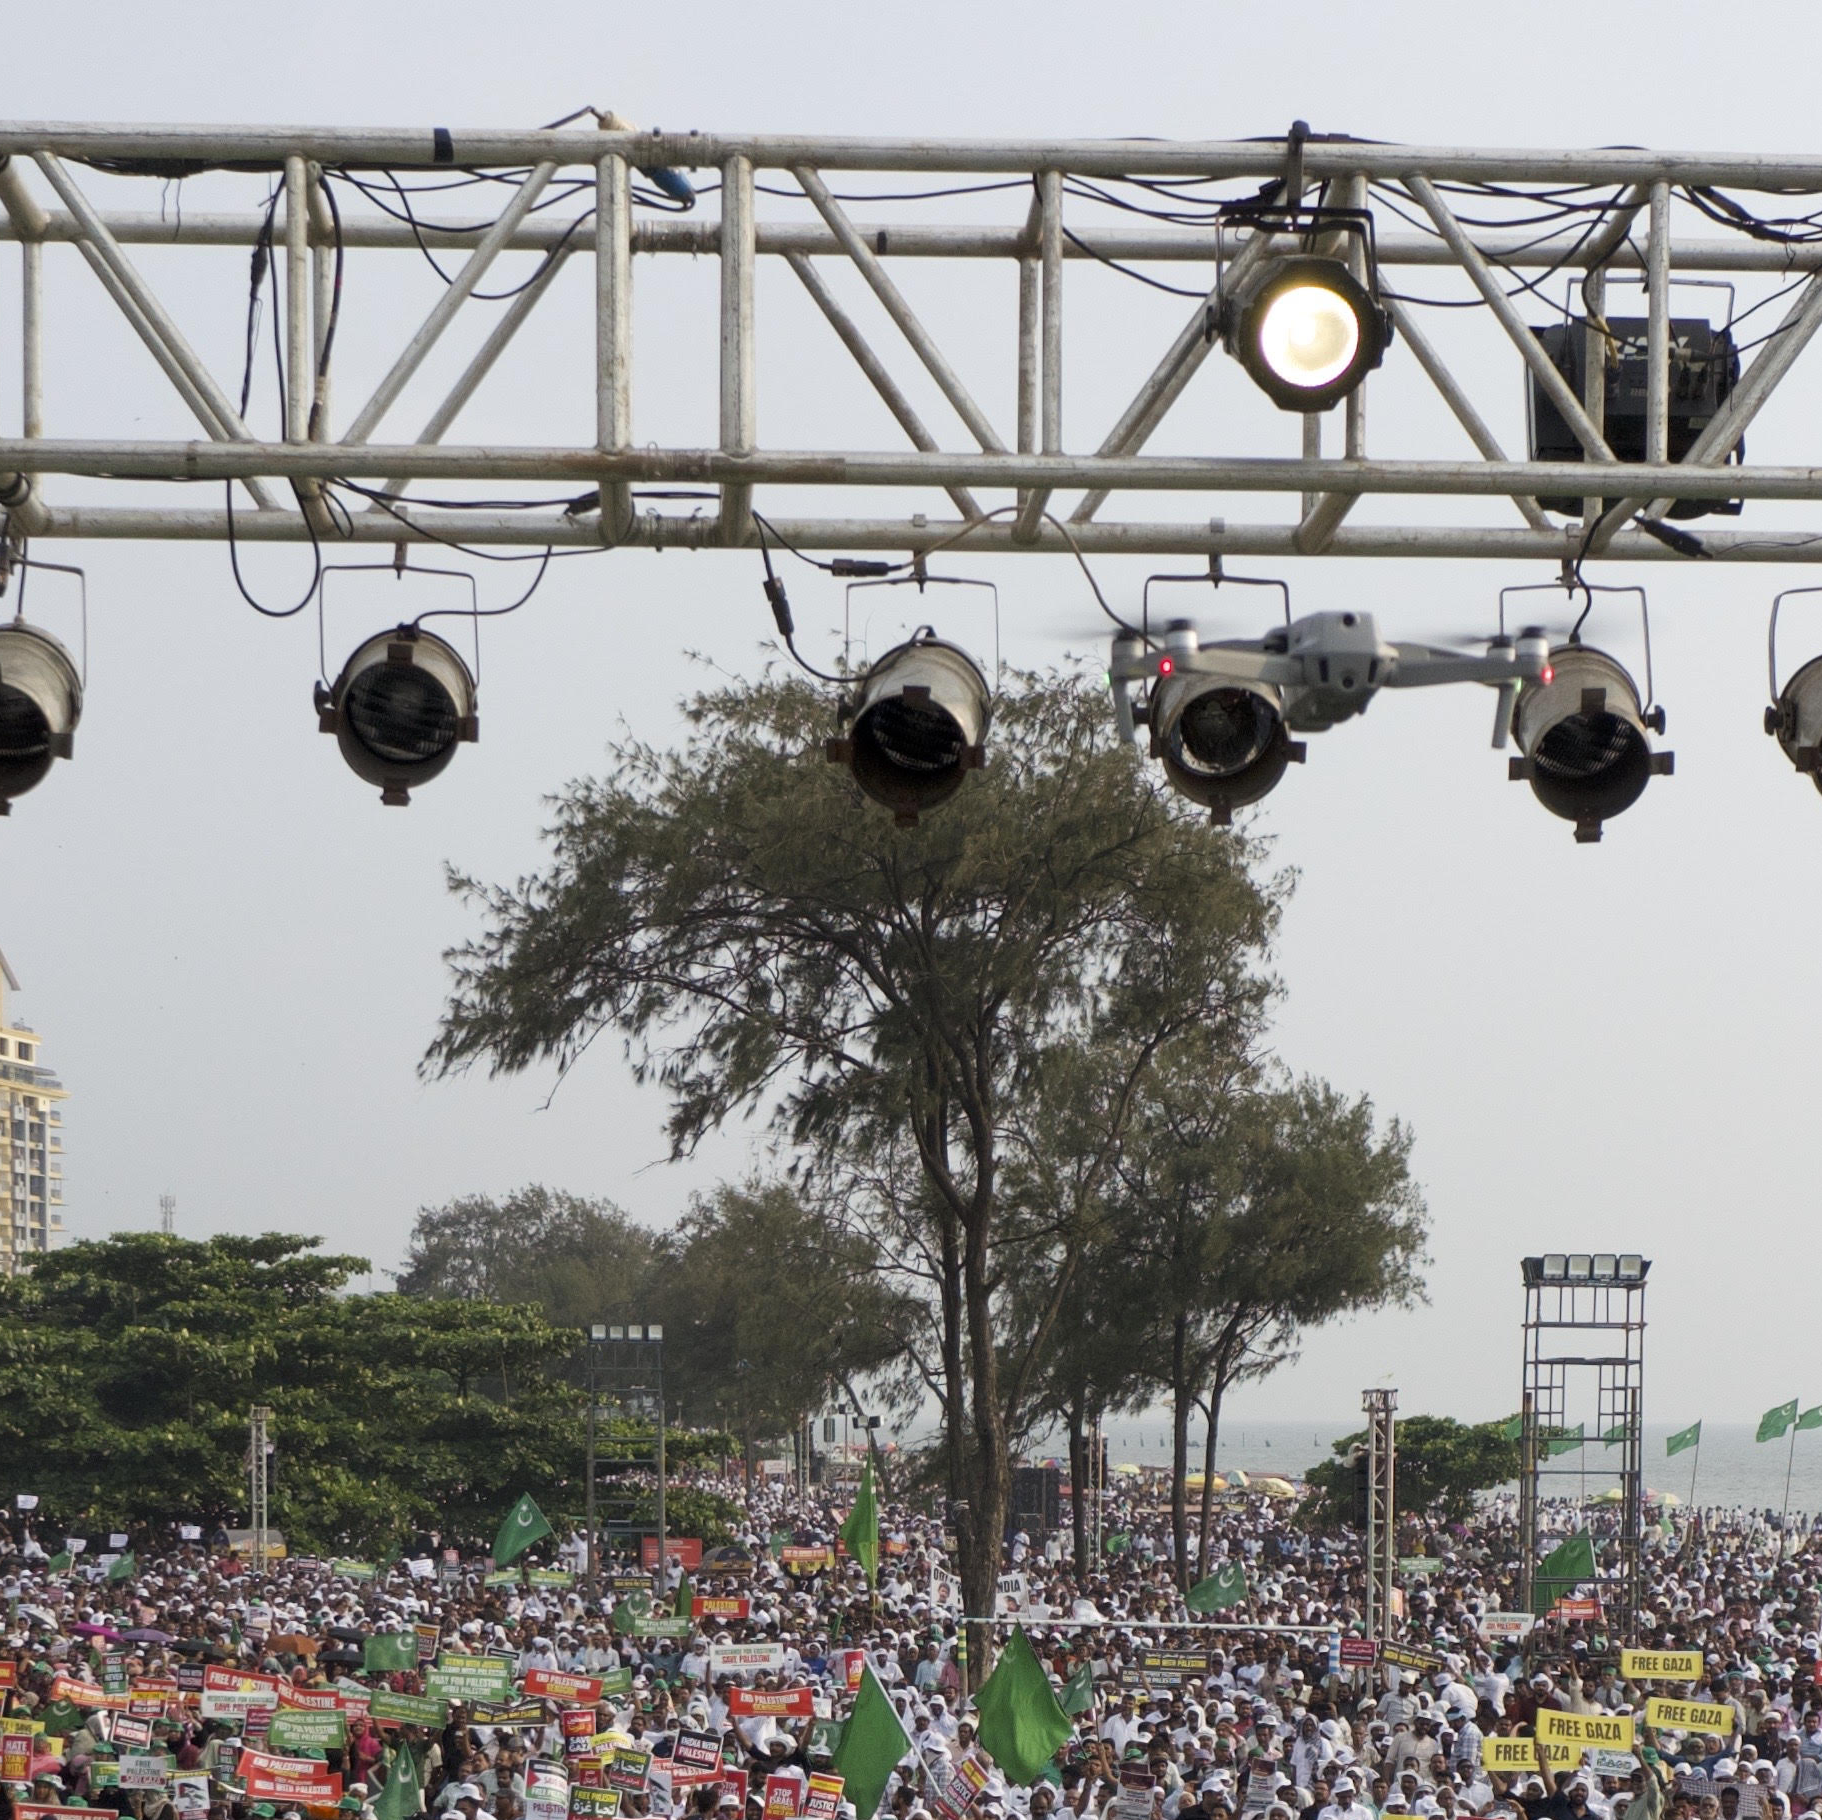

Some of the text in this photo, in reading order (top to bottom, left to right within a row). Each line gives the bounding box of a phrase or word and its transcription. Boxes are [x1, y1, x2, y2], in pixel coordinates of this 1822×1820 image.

[1632, 1656, 1692, 1672] FREE GAZA
[1657, 1704, 1722, 1725] FREE GAZA
[1549, 1718, 1622, 1740] FREE GAZA
